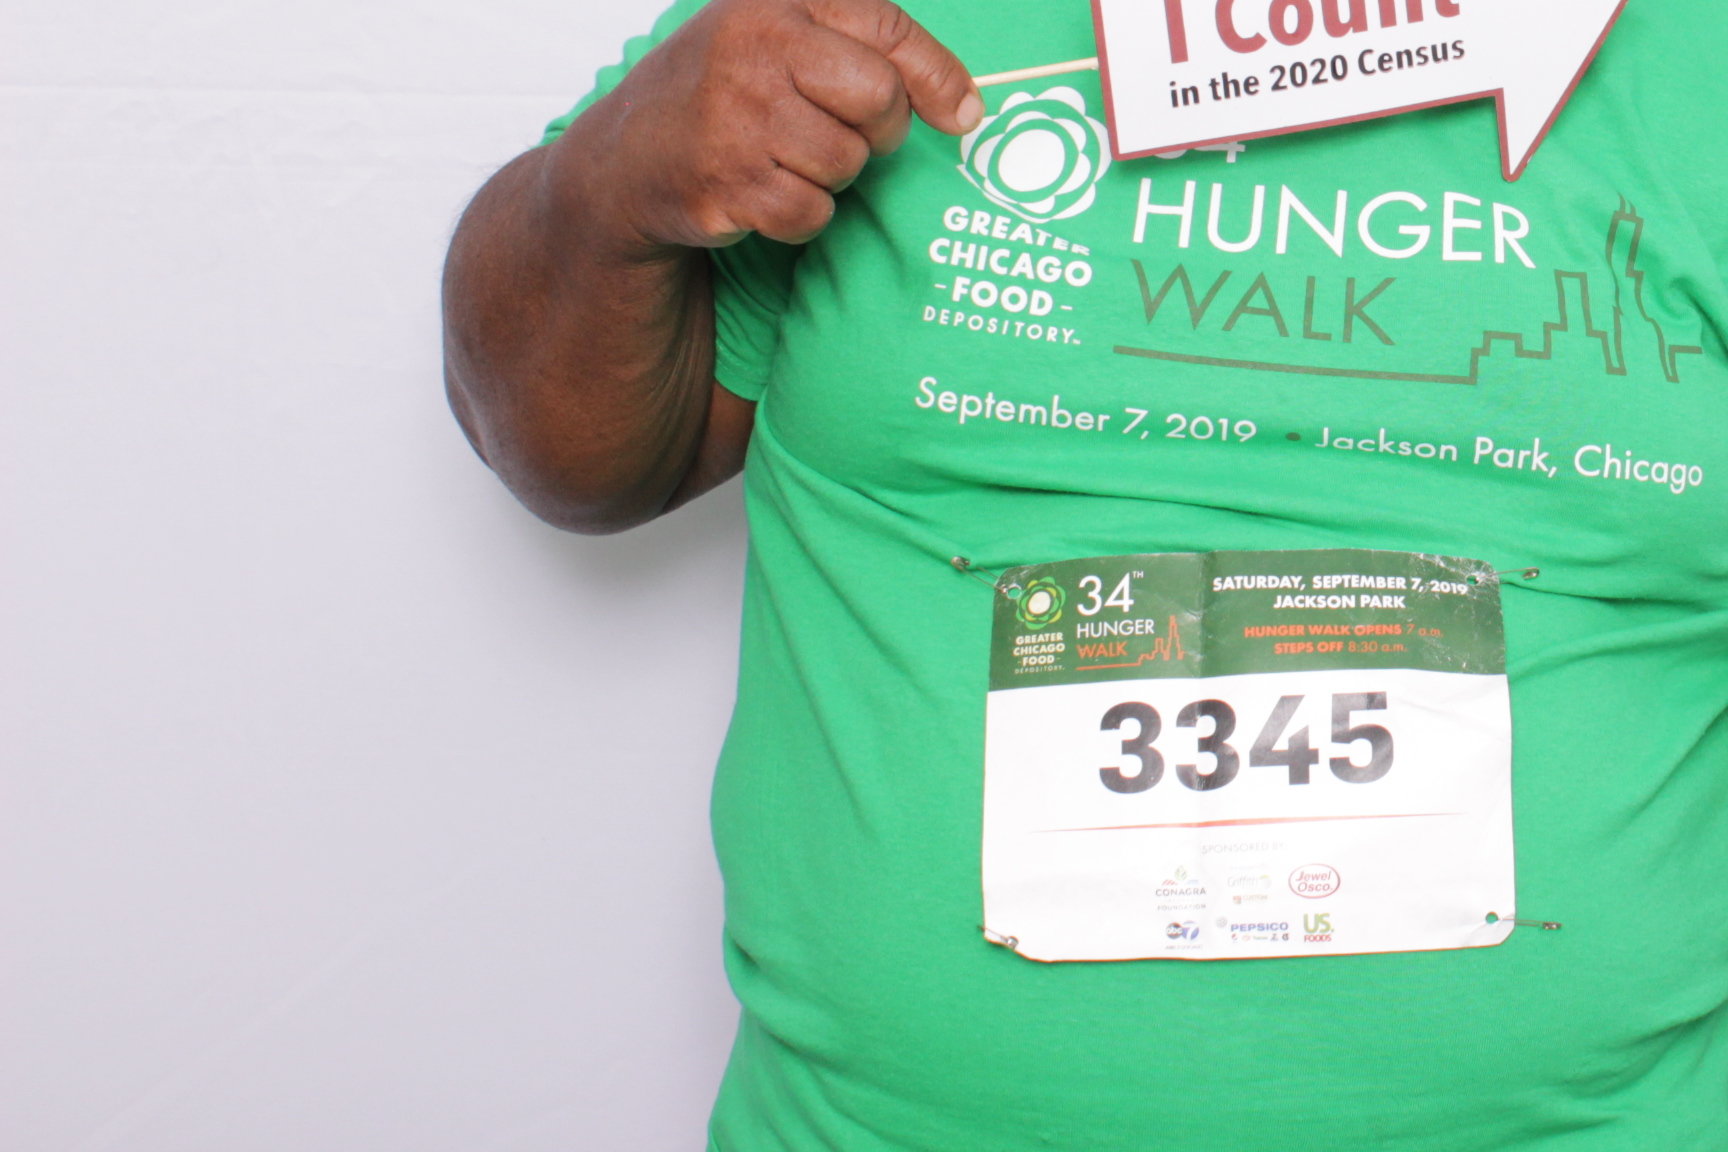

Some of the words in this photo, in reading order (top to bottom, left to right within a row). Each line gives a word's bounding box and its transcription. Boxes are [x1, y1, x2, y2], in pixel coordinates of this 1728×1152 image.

[1169, 81, 1201, 108] in
[1209, 71, 1261, 102] the
[1269, 54, 1349, 93] 2020
[1357, 39, 1466, 77] Census
[943, 205, 1091, 256] GREATER
[1132, 177, 1536, 269] HUNGER
[928, 237, 1093, 288] CHICAGO
[1130, 258, 1398, 346] WALK
[923, 305, 1075, 344] DEPOSITORY
[915, 376, 1111, 433] September
[1122, 407, 1150, 440] 7,
[1165, 413, 1258, 443] 2019
[1314, 426, 1458, 461] Jackson
[1474, 436, 1558, 478] Park,
[1573, 443, 1703, 495] Chicago
[1213, 575, 1306, 591] SATURDAY,
[1312, 574, 1407, 590] SEPTEMBER
[1411, 578, 1425, 593] 7,
[1430, 580, 1469, 596] 2019
[1273, 595, 1356, 609] JACKSON
[1360, 595, 1406, 609] PARK
[1076, 619, 1155, 639] HUNGER
[1244, 625, 1305, 638] HUNGER
[1308, 624, 1350, 636] WALK
[1353, 624, 1402, 636] OPENS
[1405, 624, 1416, 635] 7
[1417, 627, 1443, 638] a.m.
[1015, 632, 1063, 645] GREATER
[1013, 642, 1066, 657] CHICAGO
[1076, 642, 1129, 659] WALK
[1274, 642, 1314, 655] STEPS
[1316, 641, 1344, 653] OFF
[1348, 641, 1378, 653] 8:30
[1381, 643, 1407, 653] a.m.
[1098, 691, 1395, 795] 3345
[1201, 842, 1268, 855] SPONSORED
[1295, 871, 1331, 883] Jewel
[1155, 886, 1207, 898] CONAGRA
[1157, 903, 1207, 912] FOUNDATION
[1230, 921, 1289, 933] PEPSICO
[1303, 934, 1332, 943] FOODS
